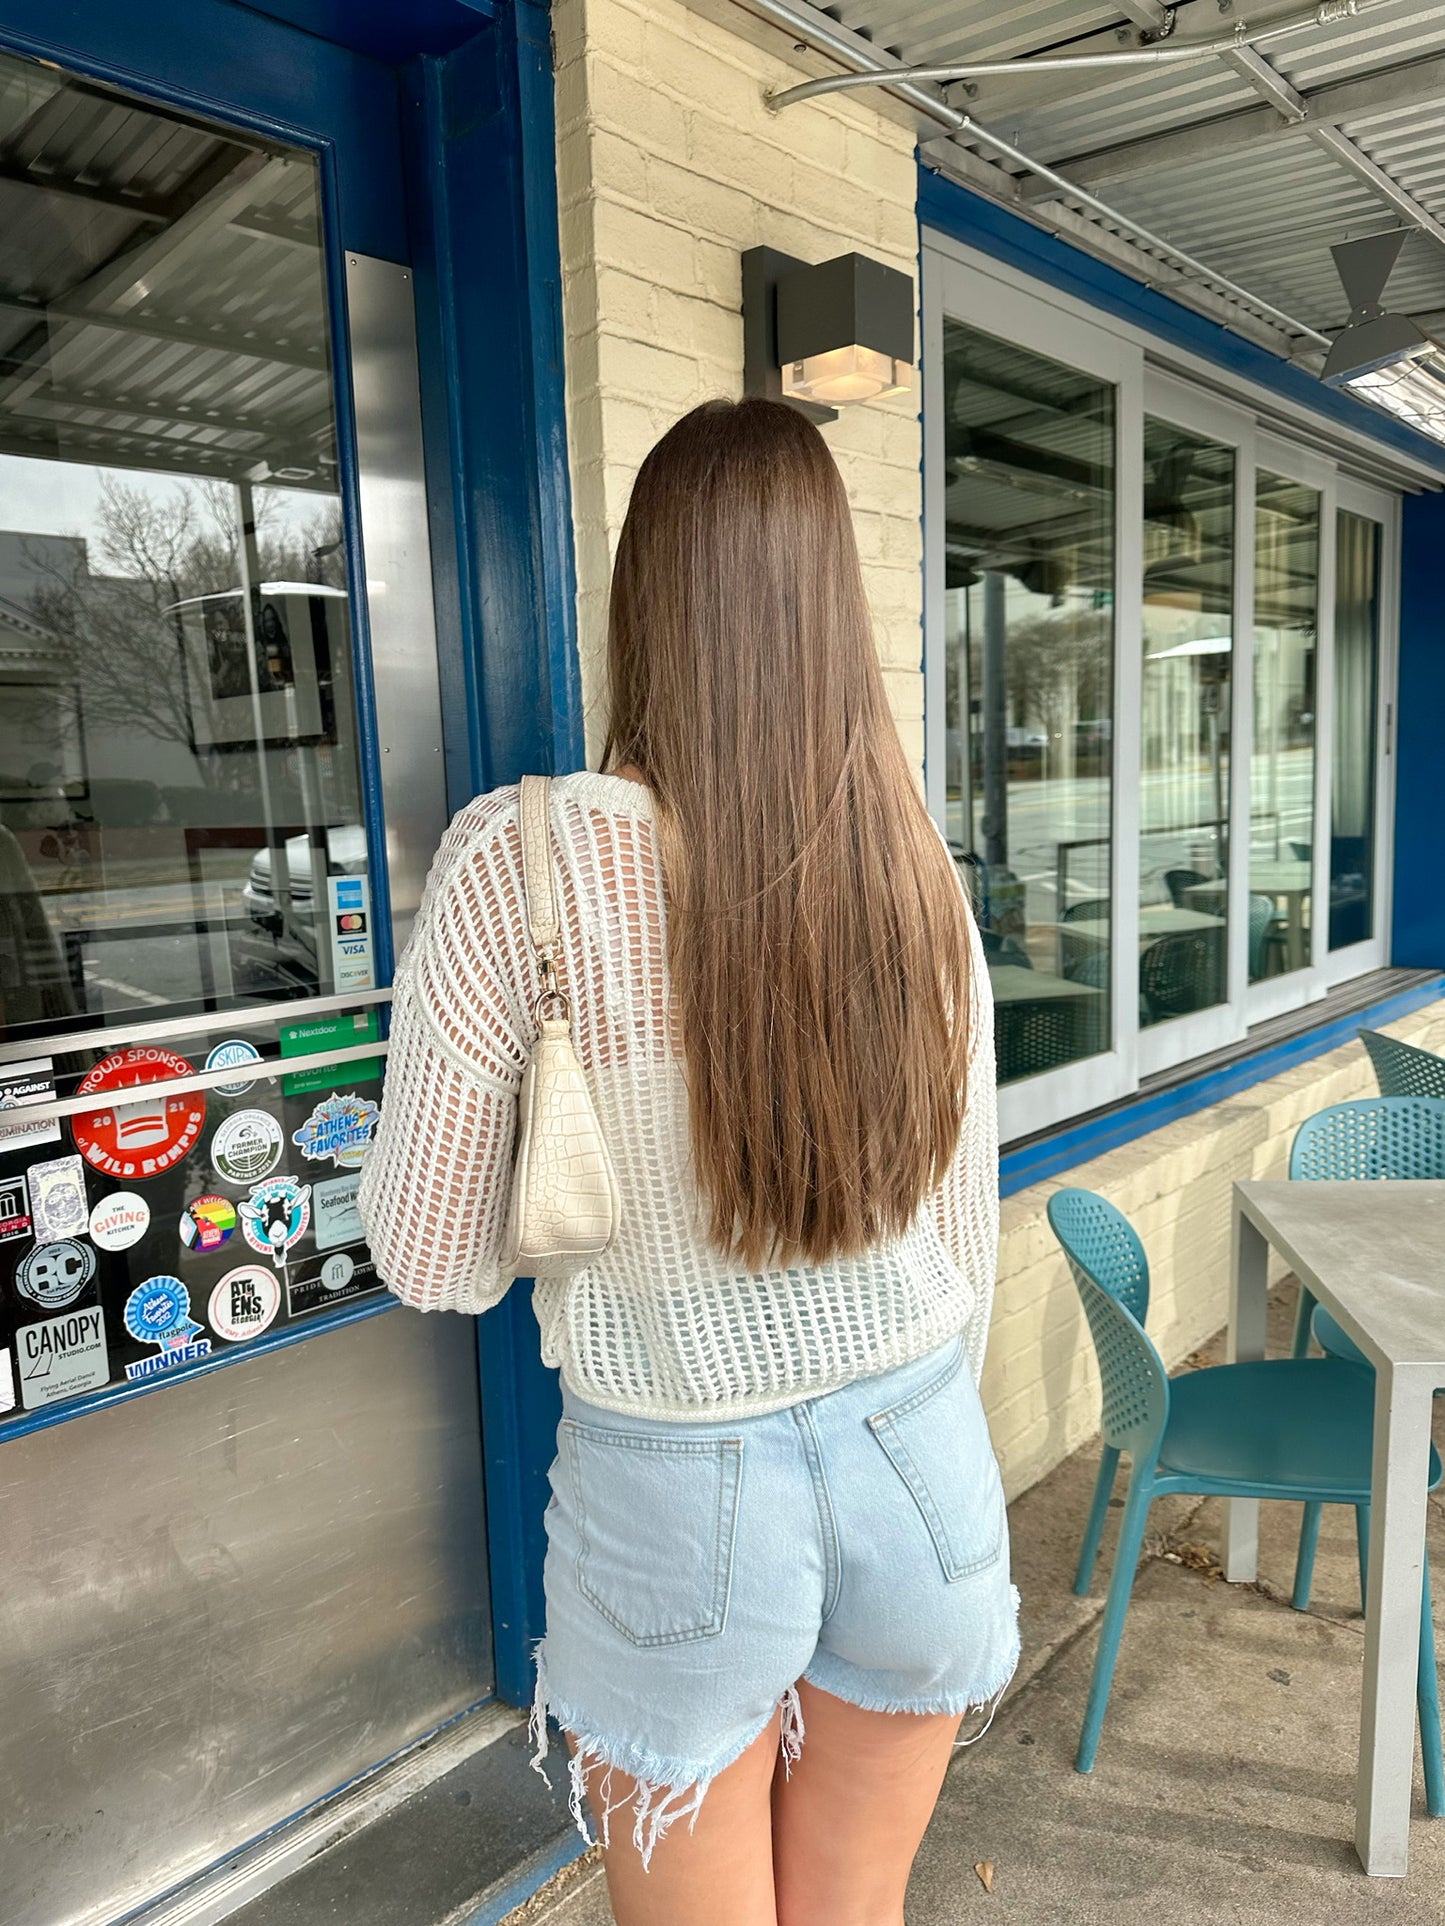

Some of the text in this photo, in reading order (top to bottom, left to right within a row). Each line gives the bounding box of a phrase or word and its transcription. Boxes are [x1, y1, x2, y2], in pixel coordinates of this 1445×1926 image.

[342, 945, 365, 955] VISA
[341, 969, 368, 978] DISCOVER
[299, 1026, 337, 1038] Nextdoor
[217, 1047, 244, 1067] SKIP
[12, 1081, 51, 1096] AGAINST
[169, 1102, 184, 1113] 21
[93, 1116, 111, 1128] 20
[316, 1112, 359, 1137] ATHENS
[77, 1112, 201, 1175] of WILD RUMPUS
[232, 1138, 263, 1150] FARMER
[310, 1124, 369, 1155] FAVORITES
[228, 1144, 267, 1158] CHAMPION
[227, 1160, 272, 1178] PARTNER 2021
[321, 1192, 350, 1209] Seafood
[0, 1216, 28, 1229] ORGIA
[0, 1221, 28, 1232] UND
[94, 1211, 145, 1233] GIVING
[107, 1224, 135, 1235] KITCHEN
[249, 1237, 272, 1252] ATHENS
[353, 1264, 376, 1276] LOYAL
[318, 1285, 360, 1302] TRADITION
[143, 1293, 168, 1311] Athens
[142, 1300, 174, 1324] Favorites
[156, 1311, 172, 1326] 2012
[231, 1314, 261, 1325] GEORGIA
[26, 1312, 100, 1359] CANOPY
[159, 1324, 194, 1340] flagpole
[58, 1342, 102, 1360] STUDIO.COM
[128, 1341, 209, 1378] WINNER
[40, 1383, 59, 1392] Flying
[60, 1375, 76, 1386] Aerial
[46, 1380, 92, 1398] Athens, Georgia
